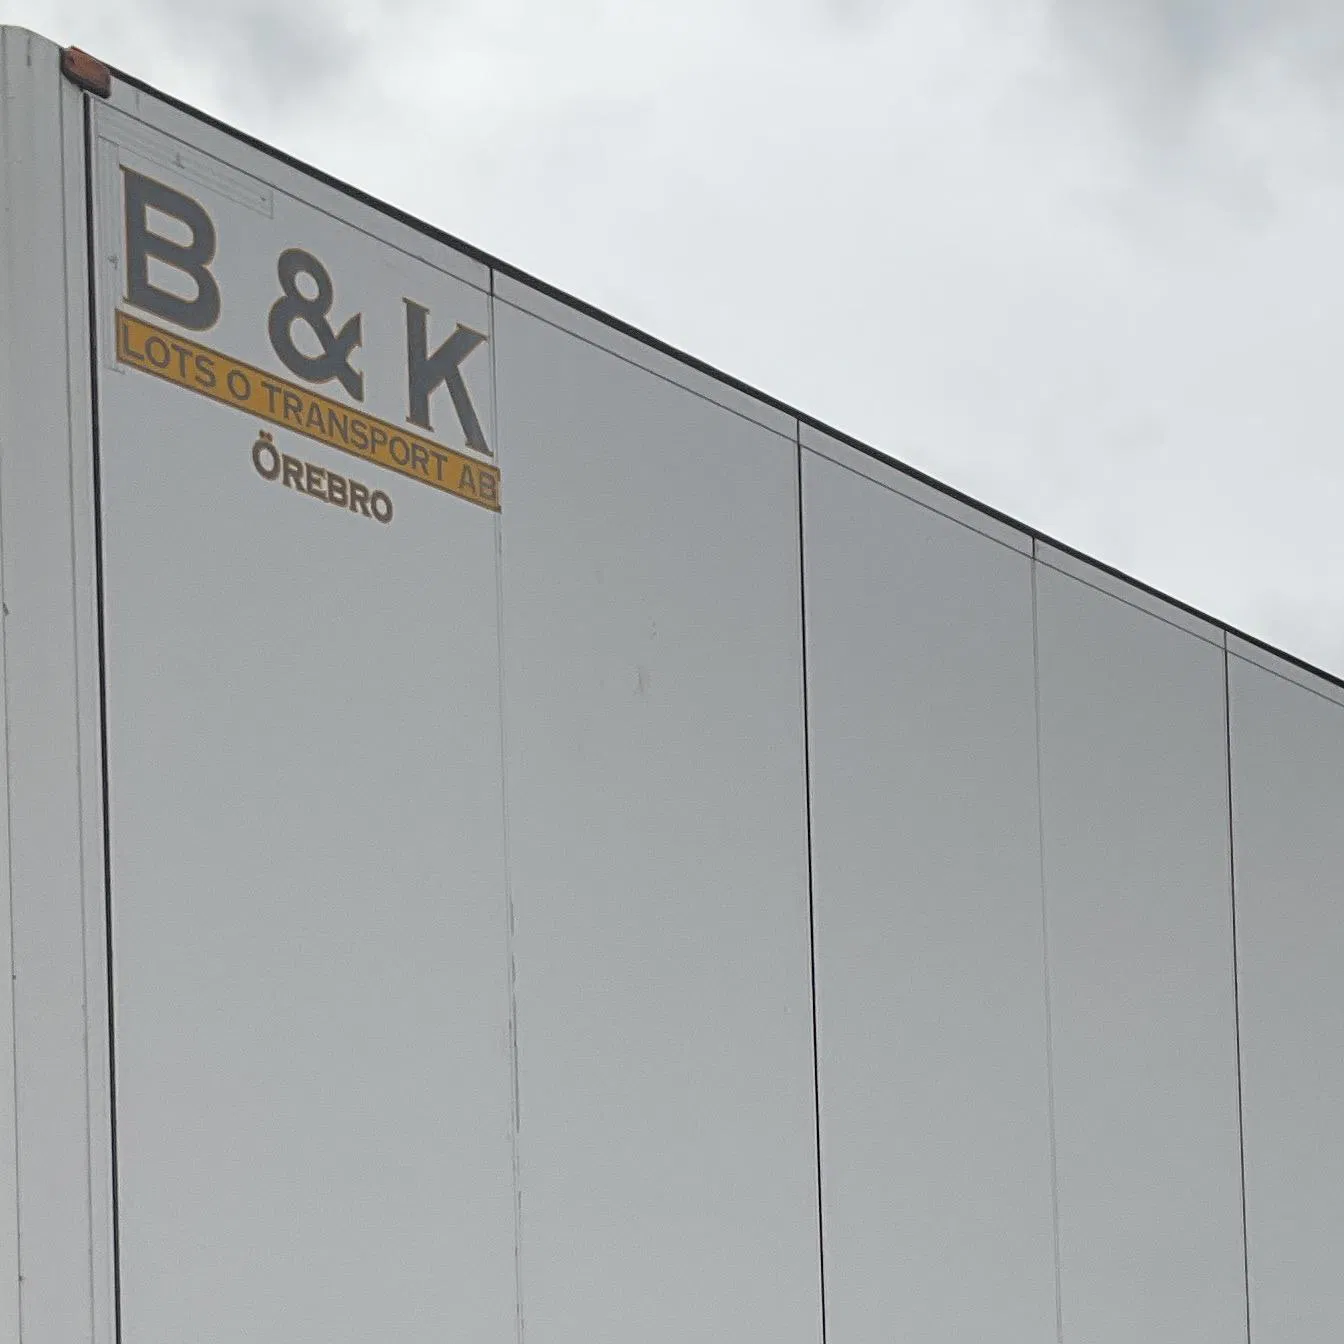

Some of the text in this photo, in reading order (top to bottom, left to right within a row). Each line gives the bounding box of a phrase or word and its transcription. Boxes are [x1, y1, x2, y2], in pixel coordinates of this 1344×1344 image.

[119, 164, 494, 457] B & K
[122, 326, 498, 501] LOTS O TRANSPORT AB
[251, 429, 394, 525] ÖREBRO
